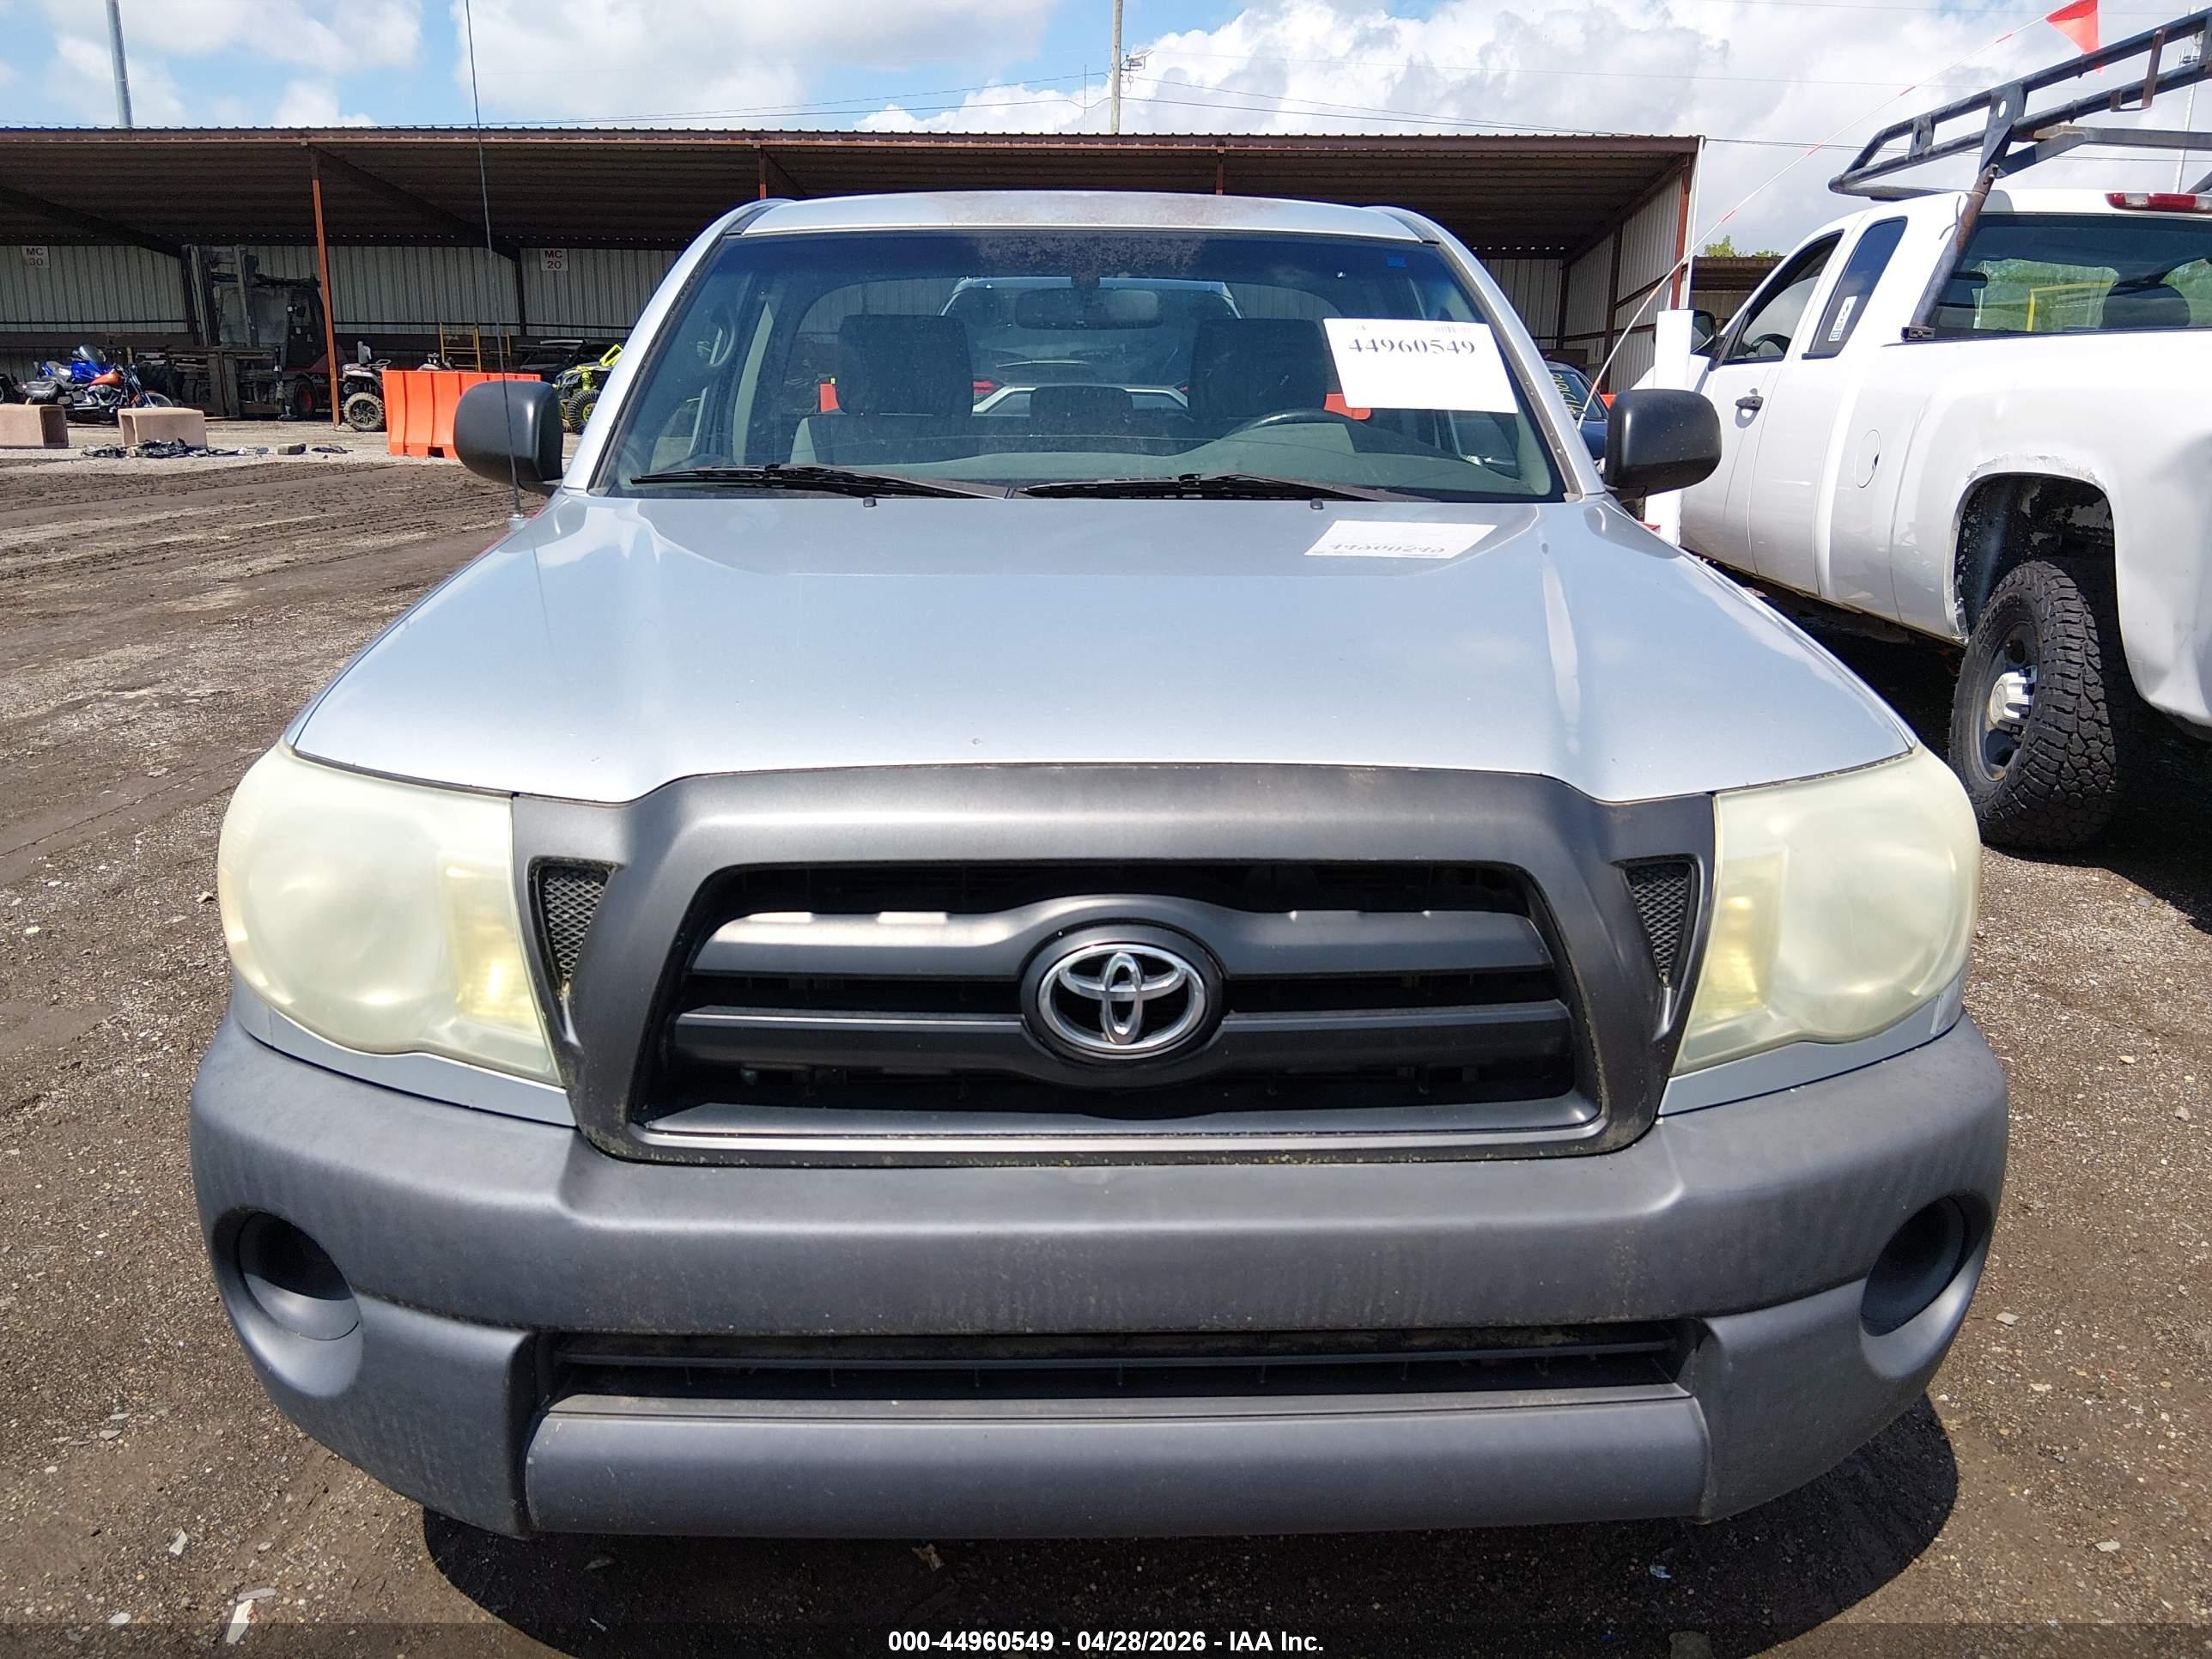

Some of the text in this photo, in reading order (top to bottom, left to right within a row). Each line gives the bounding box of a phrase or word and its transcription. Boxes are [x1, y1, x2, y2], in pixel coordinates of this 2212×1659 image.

[27, 247, 43, 256] MC
[544, 250, 563, 258] MC
[1348, 338, 1475, 354] 44960549
